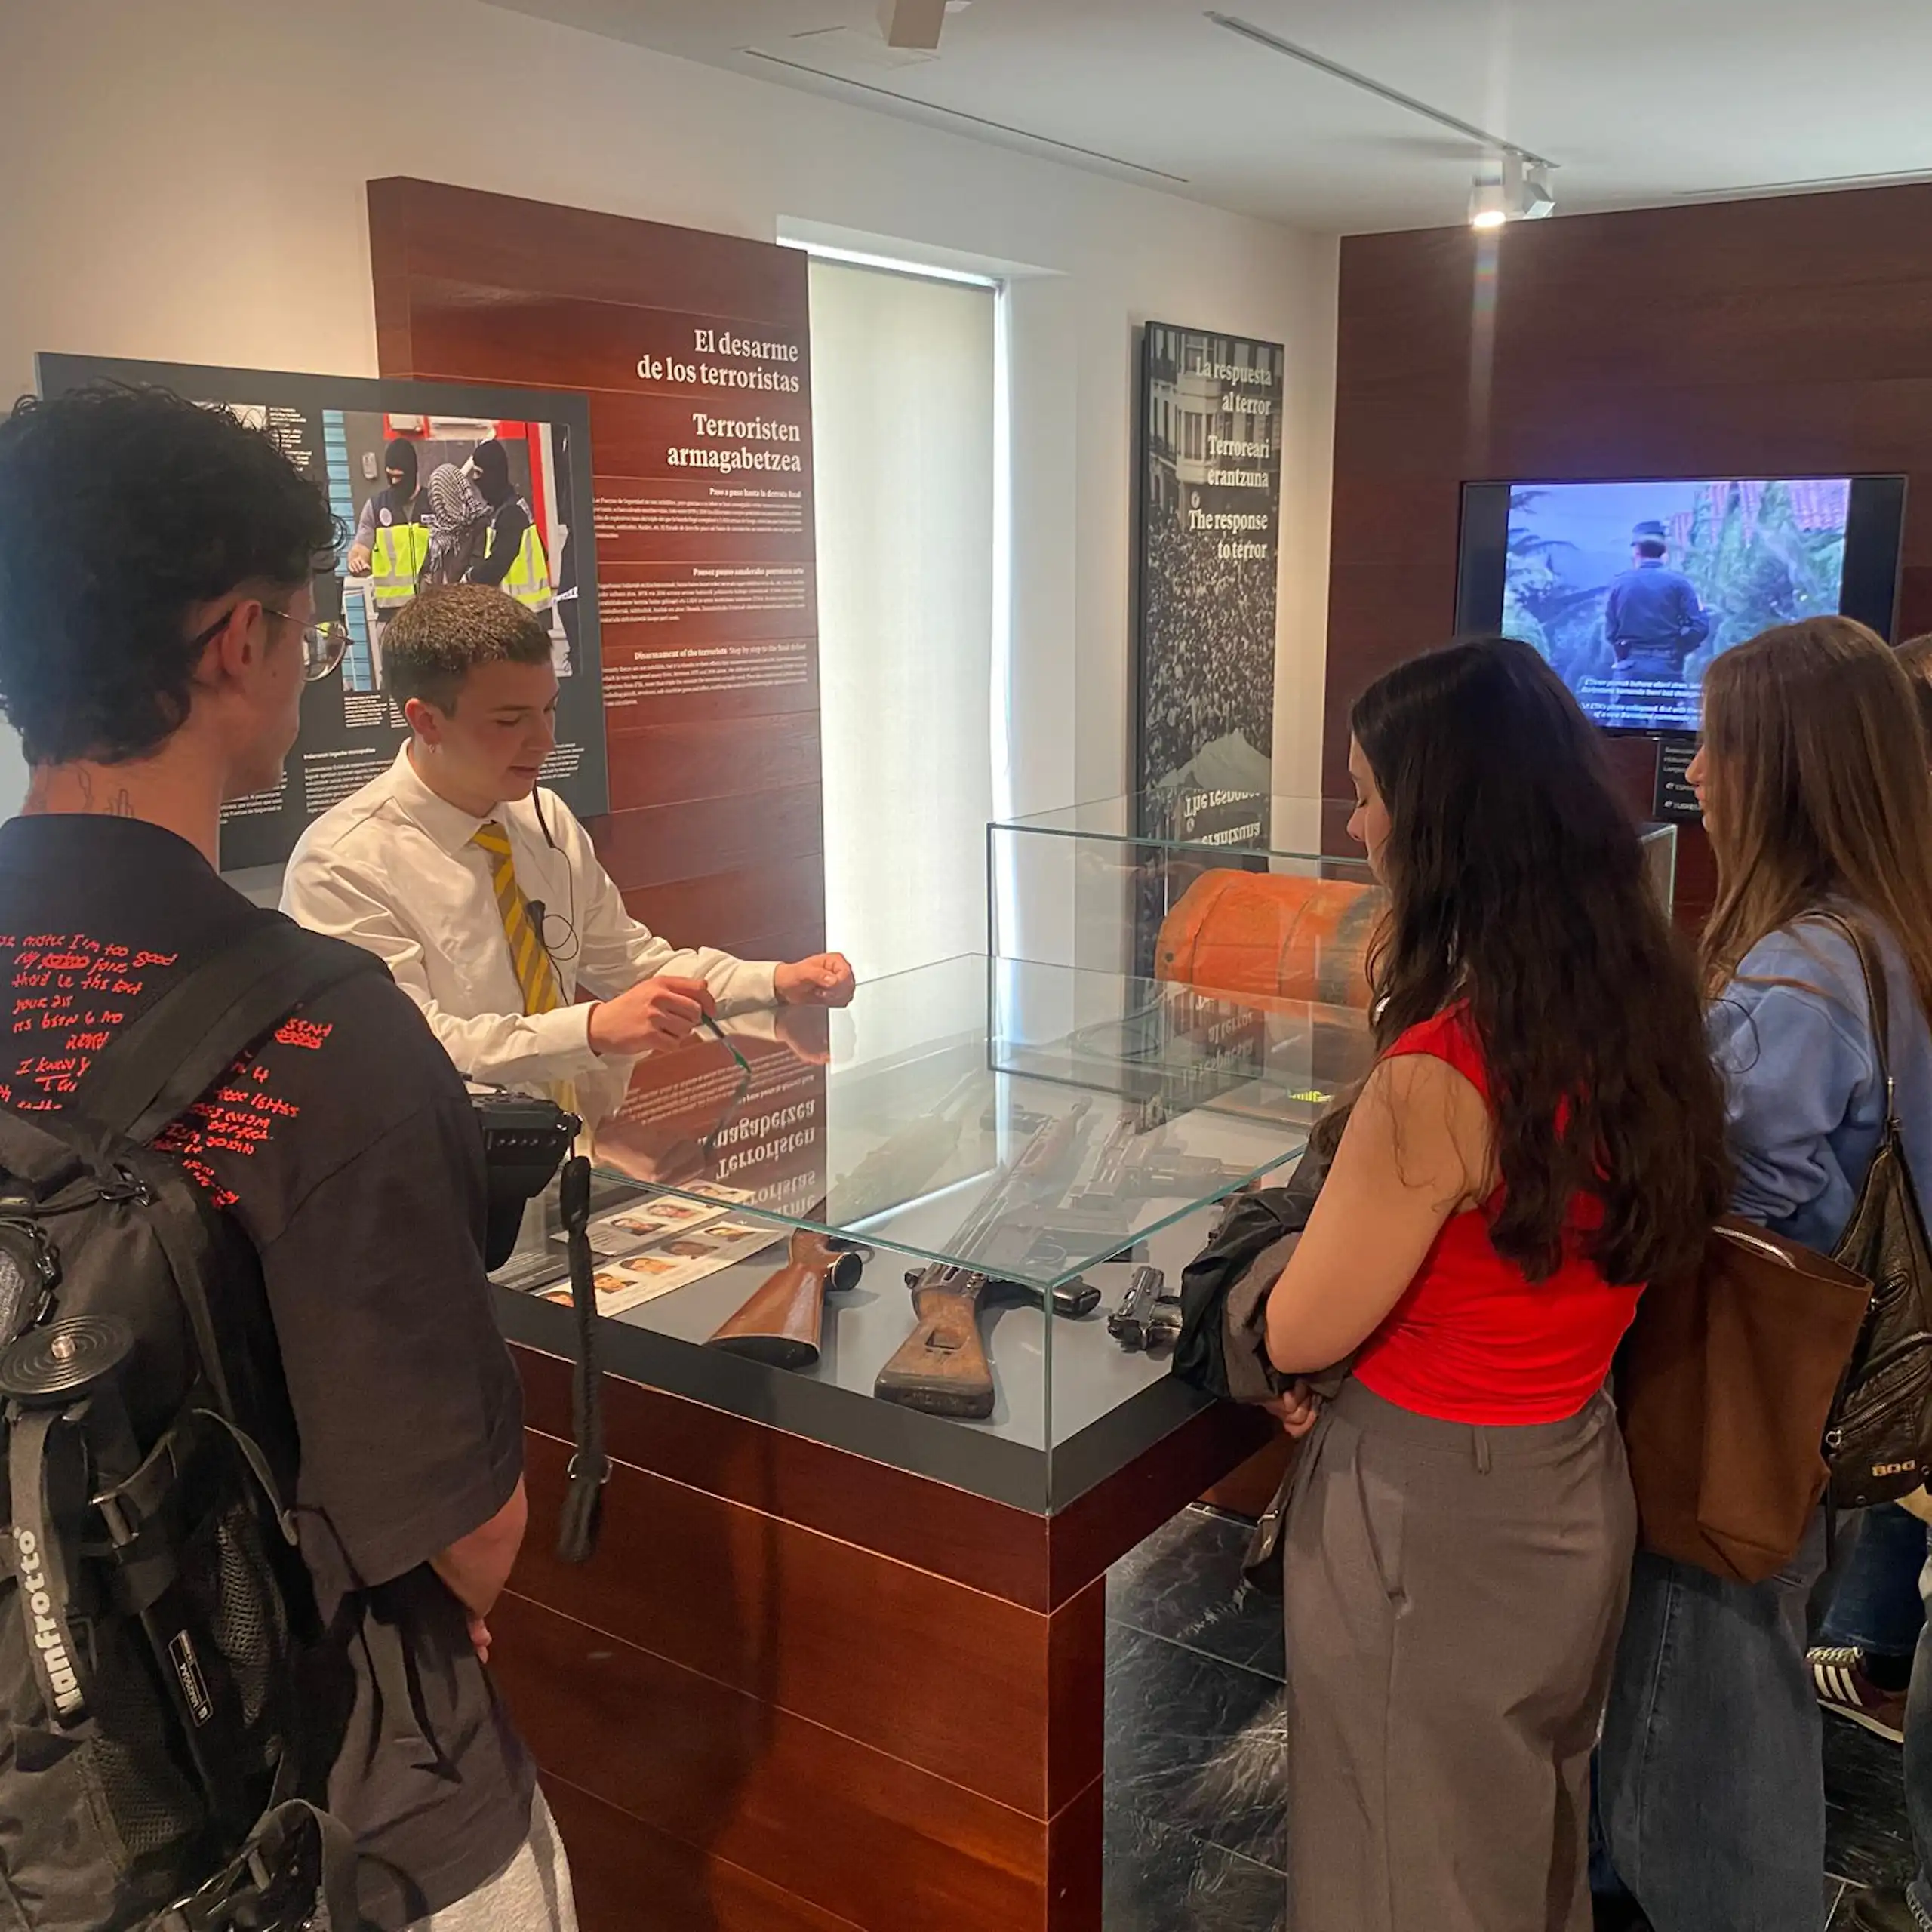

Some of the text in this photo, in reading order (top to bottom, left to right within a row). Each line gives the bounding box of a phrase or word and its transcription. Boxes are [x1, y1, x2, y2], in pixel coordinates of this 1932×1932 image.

[694, 329, 799, 362] El desarme
[636, 355, 800, 393] de los terroristas
[1195, 357, 1272, 386] La respuesta
[1222, 392, 1272, 415] al terror
[693, 413, 801, 442] Terroristen
[667, 446, 801, 474] armagabetzea
[1208, 435, 1270, 459] Terroreari
[1208, 469, 1269, 488] erantzuna
[1189, 509, 1268, 534] The response
[1217, 540, 1268, 561] to terror
[18, 1530, 85, 1715] Manfrotto
